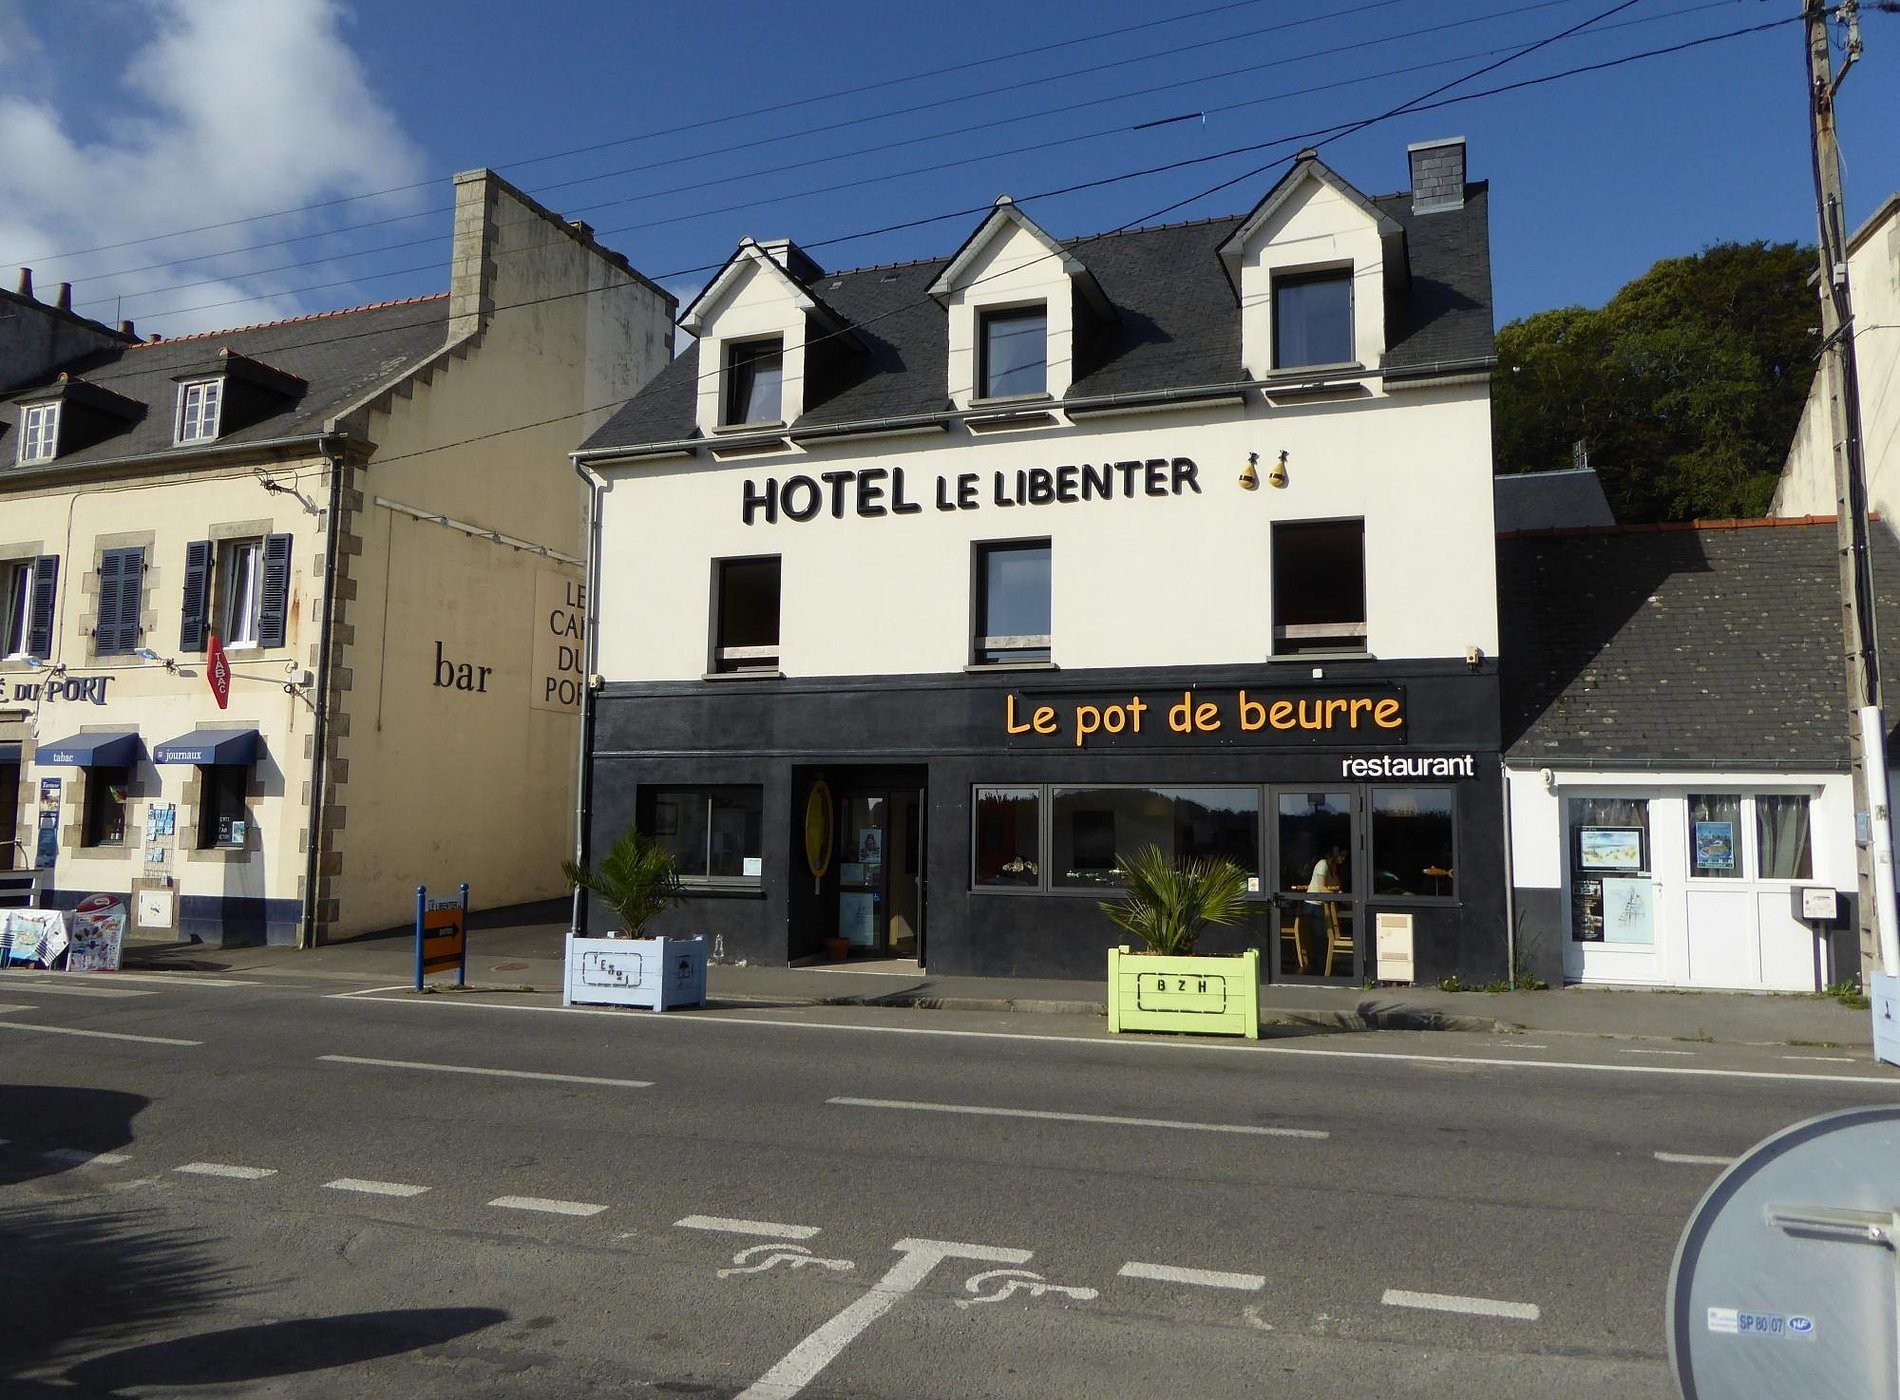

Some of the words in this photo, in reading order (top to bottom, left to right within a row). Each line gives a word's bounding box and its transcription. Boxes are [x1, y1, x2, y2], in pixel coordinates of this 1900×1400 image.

[742, 466, 921, 525] HOTEL
[936, 473, 980, 512] LE
[994, 456, 1202, 508] LIBENTER
[566, 581, 586, 609] LE
[215, 653, 226, 694] TABAC
[433, 641, 492, 693] bar
[13, 684, 41, 701] DU
[46, 676, 115, 705] PORT
[1006, 694, 1057, 735] Le
[1075, 696, 1147, 747] pot
[1168, 691, 1221, 734] de
[1239, 690, 1402, 731] beurre
[53, 752, 73, 763] tabac
[165, 749, 201, 762] journaux
[1341, 754, 1475, 779] restaurant
[1740, 1314, 1753, 1330] SP
[1771, 1317, 1784, 1333] 07
